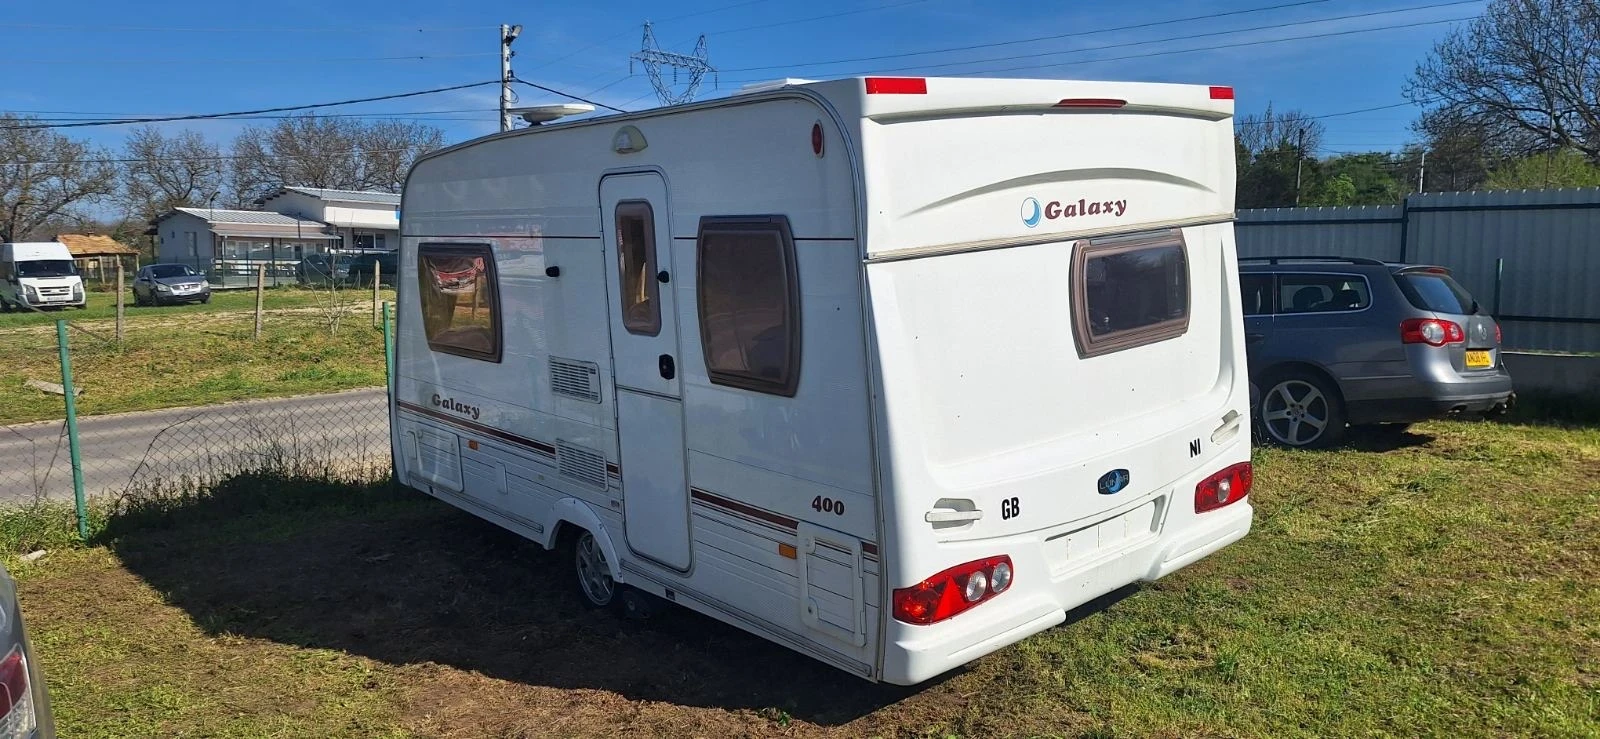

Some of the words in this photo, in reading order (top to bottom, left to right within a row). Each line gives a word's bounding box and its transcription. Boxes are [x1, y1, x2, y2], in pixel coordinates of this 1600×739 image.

[1044, 198, 1127, 220] Galaxy
[431, 393, 480, 420] Galaxy
[1189, 437, 1201, 458] NI
[811, 495, 845, 516] 400
[1001, 496, 1020, 521] GB
